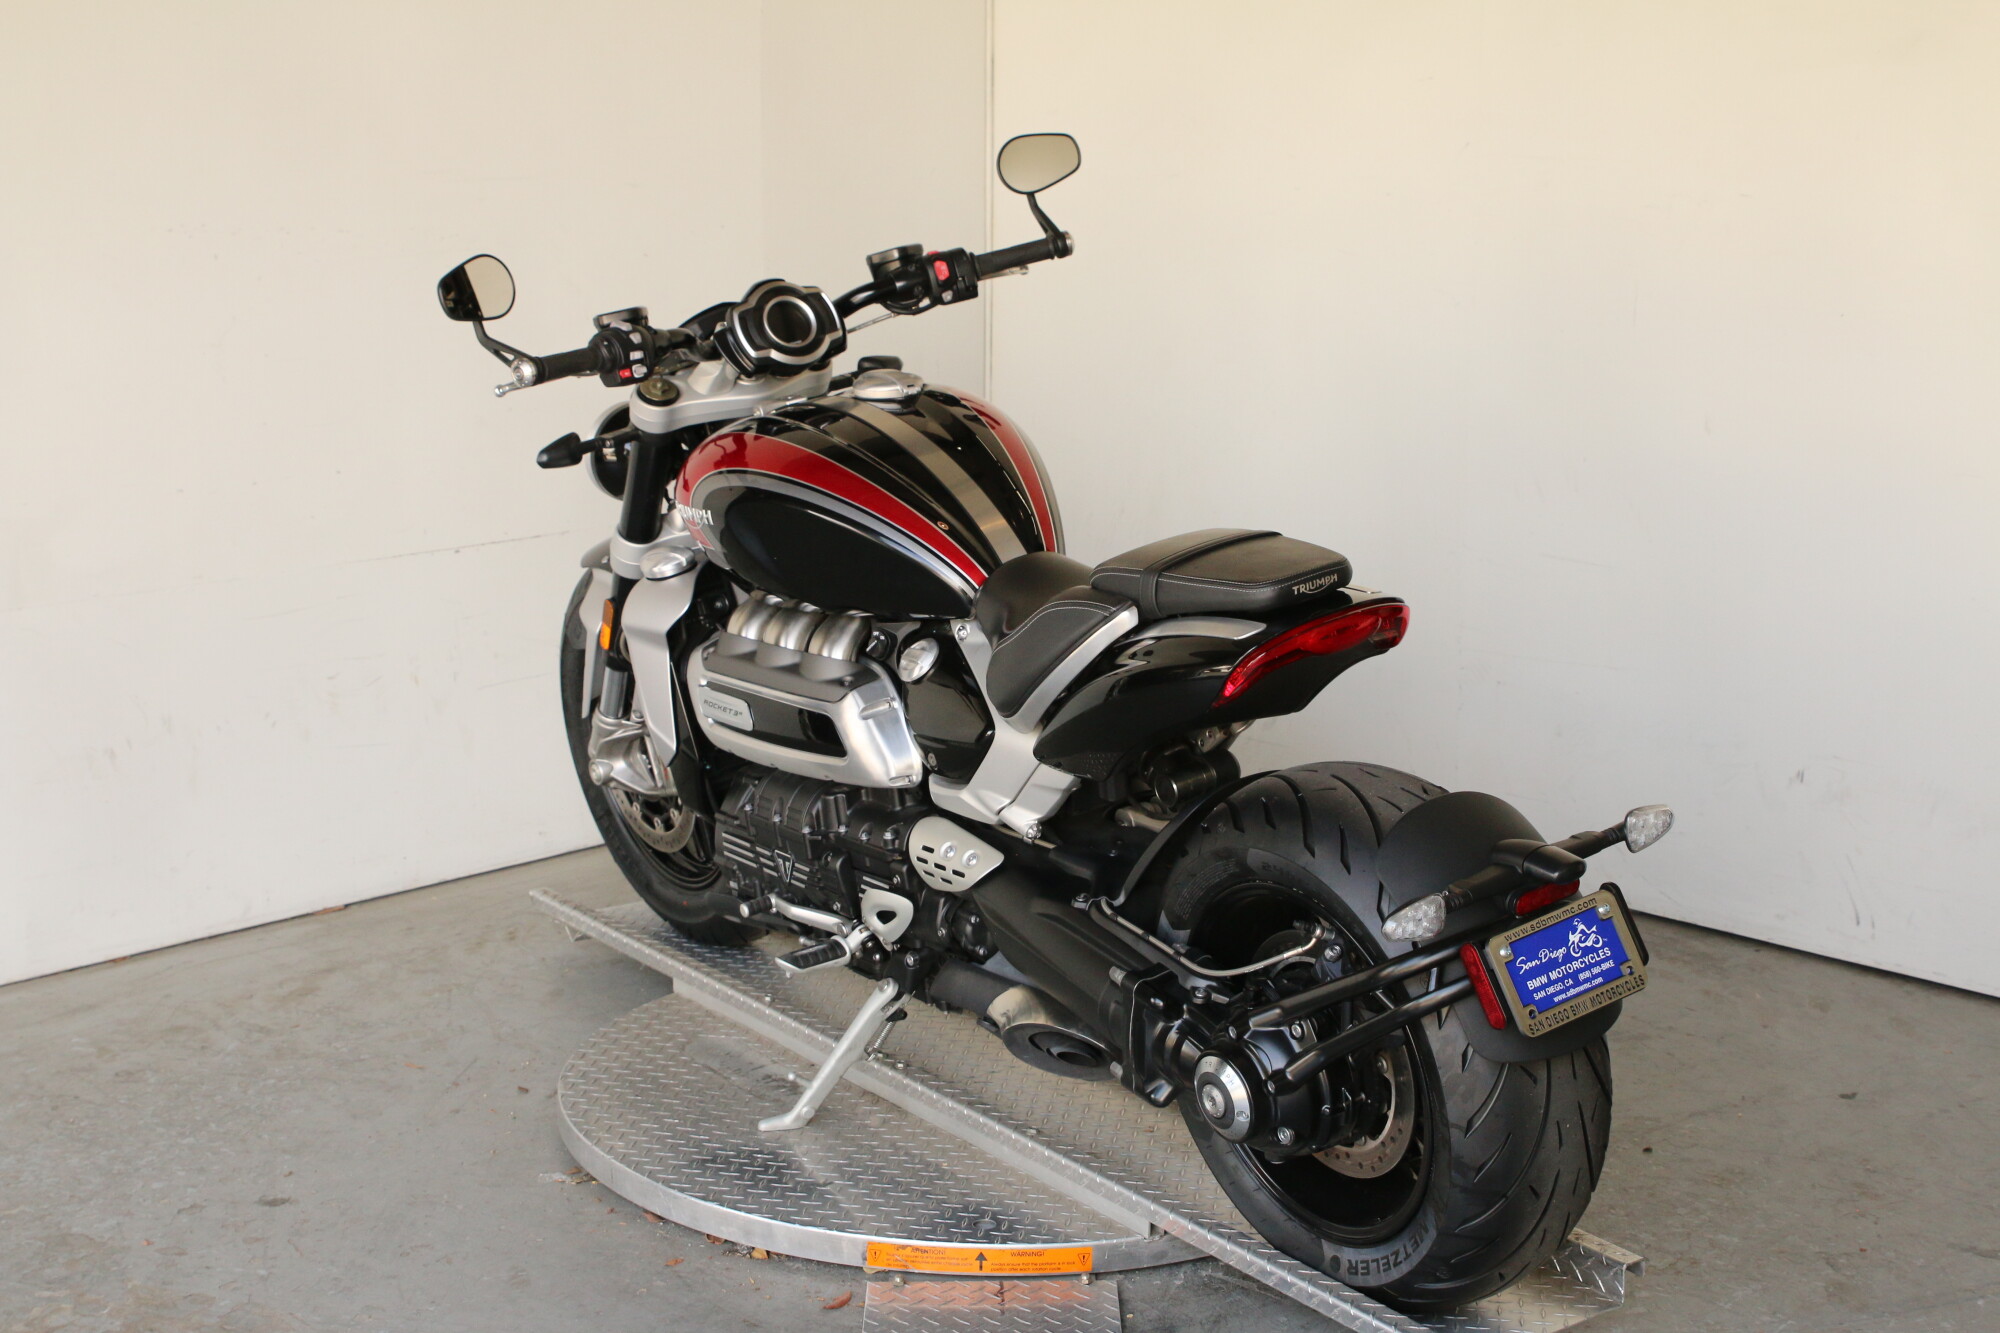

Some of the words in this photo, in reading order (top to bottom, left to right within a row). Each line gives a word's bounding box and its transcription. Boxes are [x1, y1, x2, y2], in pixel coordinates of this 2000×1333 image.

[1292, 573, 1338, 596] TRIUMPH
[1504, 897, 1598, 941] www.sdbmwmc.com
[1516, 956, 1540, 975] San
[1538, 946, 1567, 963] Diego
[1526, 974, 1548, 991] BMW
[1548, 947, 1612, 981] MOTORCYCLES
[1528, 1018, 1546, 1035] SAN
[1545, 1008, 1570, 1028] DIEGO
[1569, 1000, 1591, 1017] BMW
[1589, 974, 1645, 1009] MOTORCYCLES
[1533, 990, 1546, 1001] SAN
[1546, 982, 1566, 996] DIEGO,
[1564, 978, 1574, 988] CA
[1553, 976, 1604, 1003] www.sdbmwmc.com
[1346, 1220, 1430, 1276] METZELER
